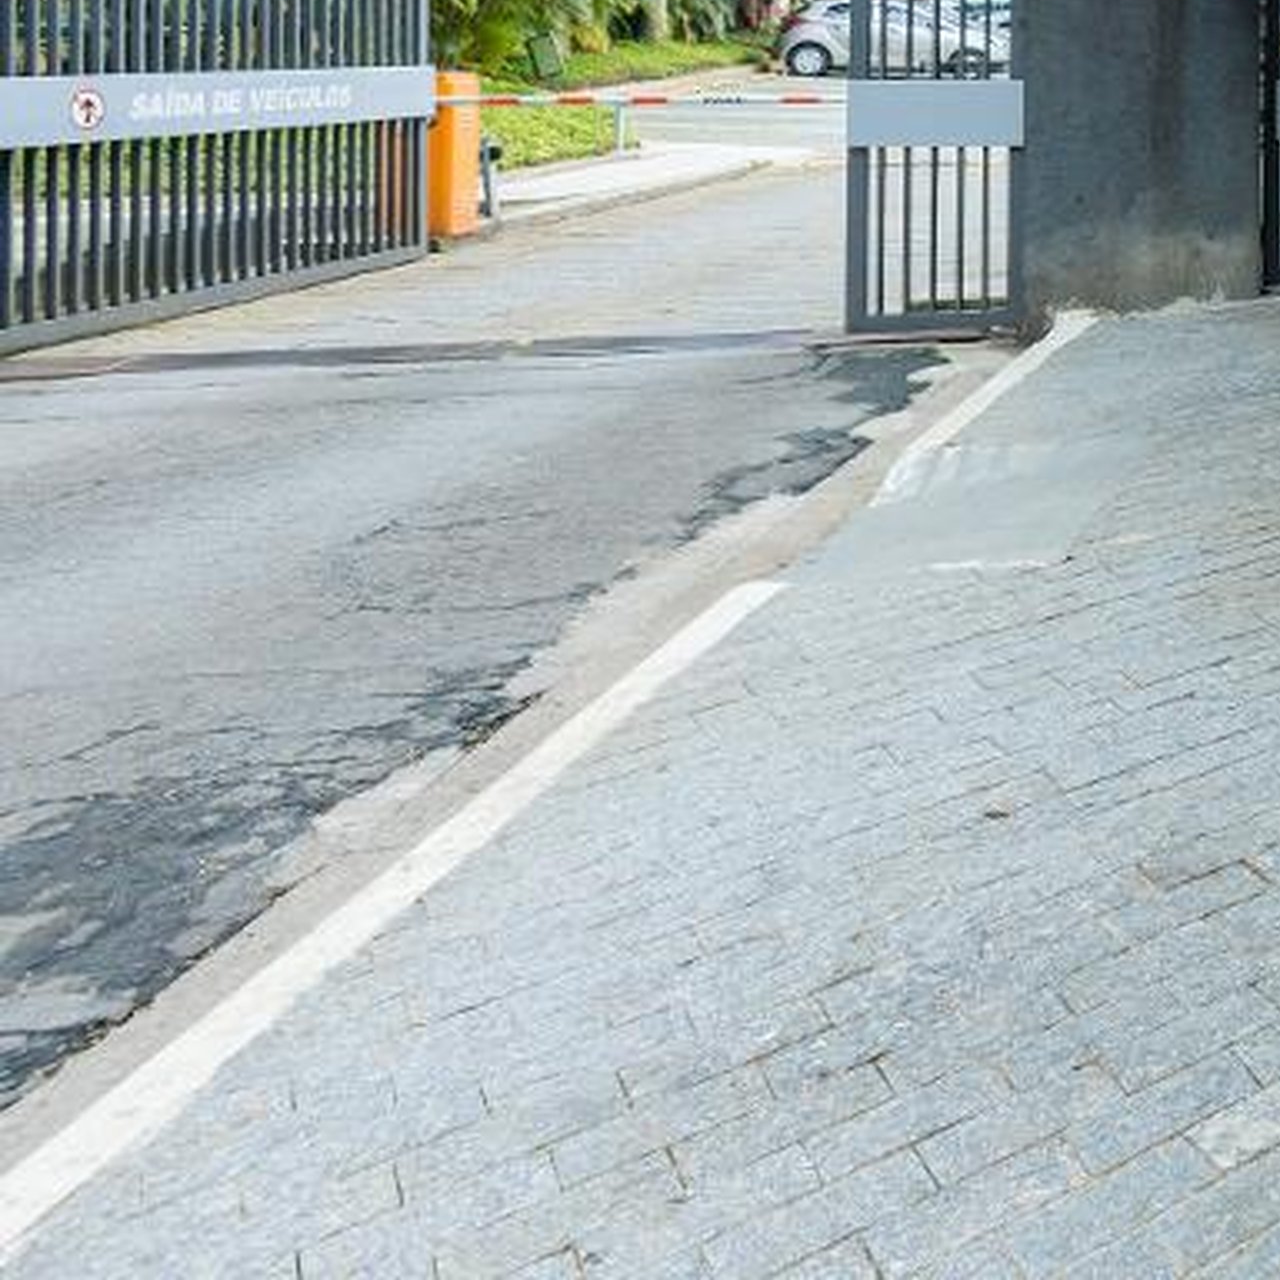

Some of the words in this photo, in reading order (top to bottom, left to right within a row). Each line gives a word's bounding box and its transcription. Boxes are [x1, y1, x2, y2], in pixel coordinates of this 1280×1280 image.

[130, 83, 205, 119] SAÍDA
[211, 89, 242, 114] DE
[250, 79, 352, 111] VEÍCULOS
